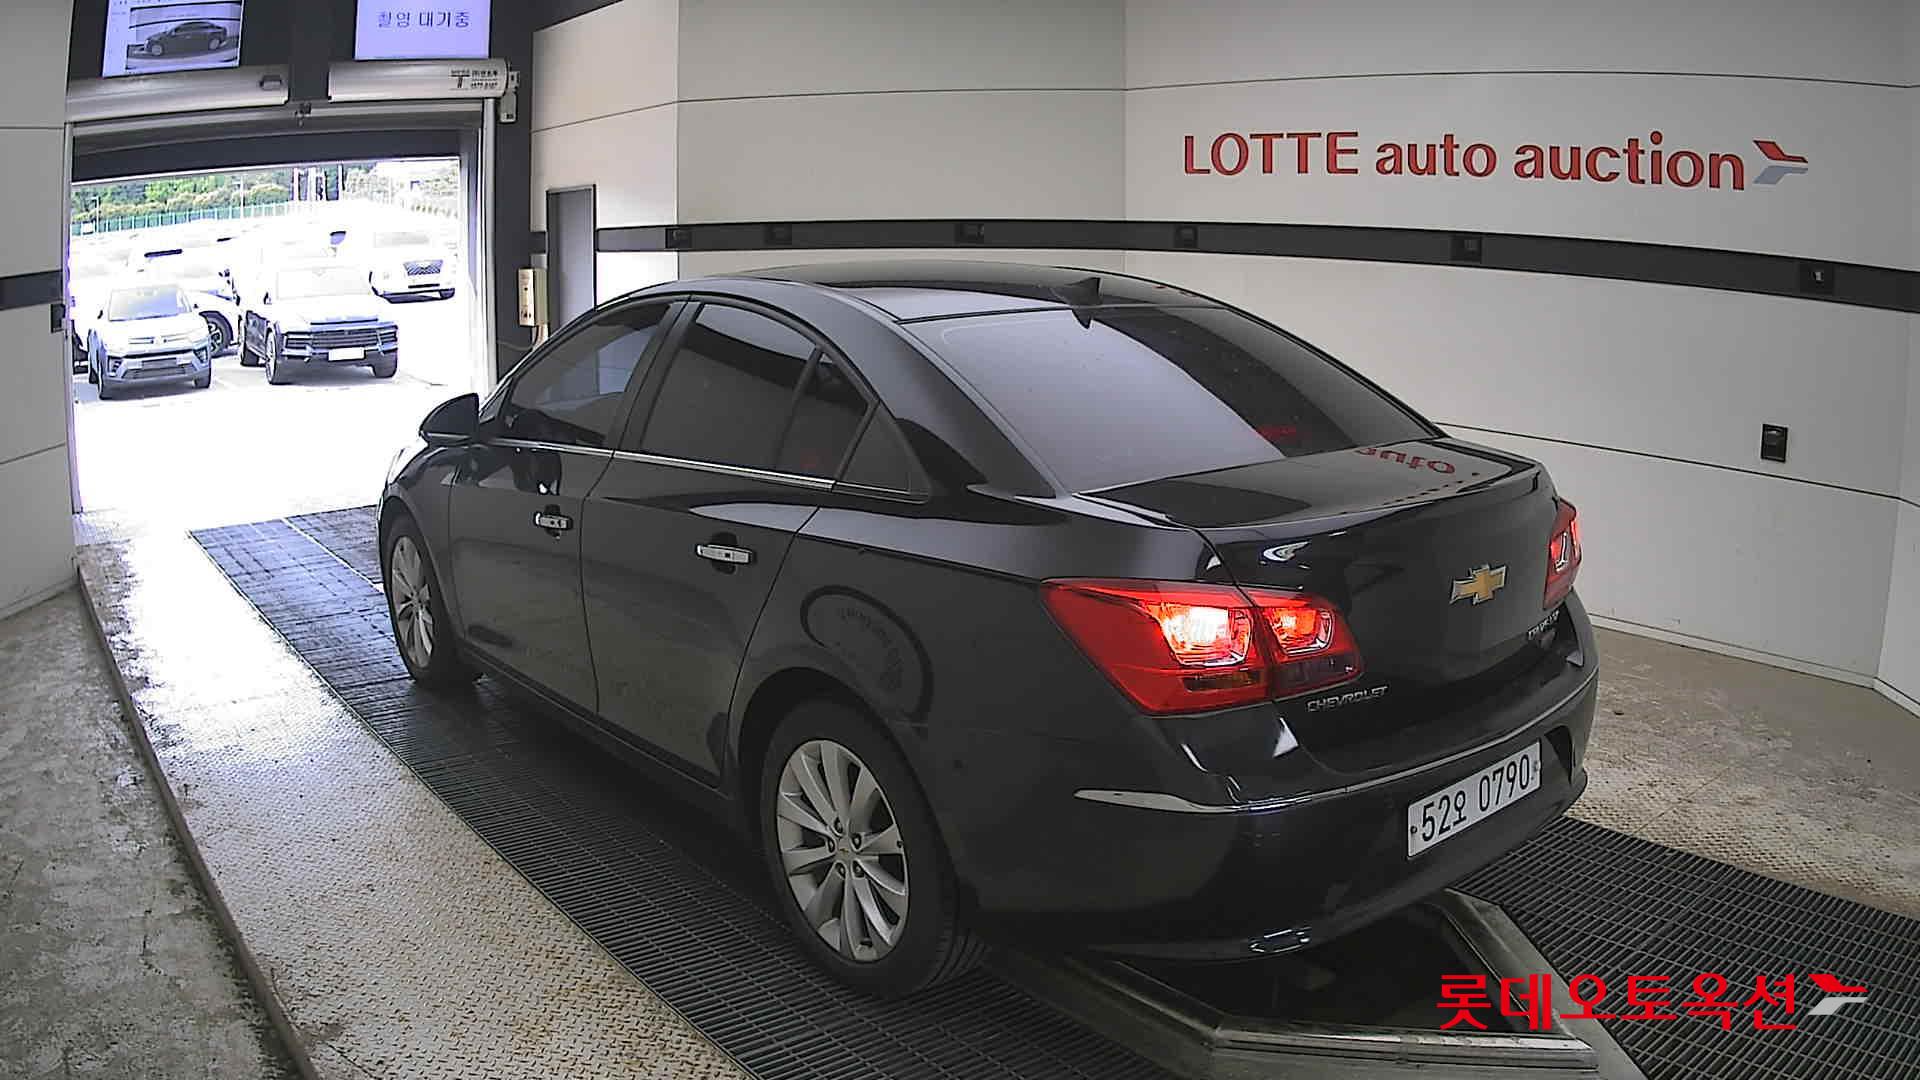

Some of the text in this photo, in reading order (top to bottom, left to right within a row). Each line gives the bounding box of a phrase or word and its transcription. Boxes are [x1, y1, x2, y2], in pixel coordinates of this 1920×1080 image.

[1184, 130, 1746, 191] LOTTE auto auction
[1307, 685, 1388, 712] CHEVROLET
[1422, 754, 1530, 842] 52오 0790
